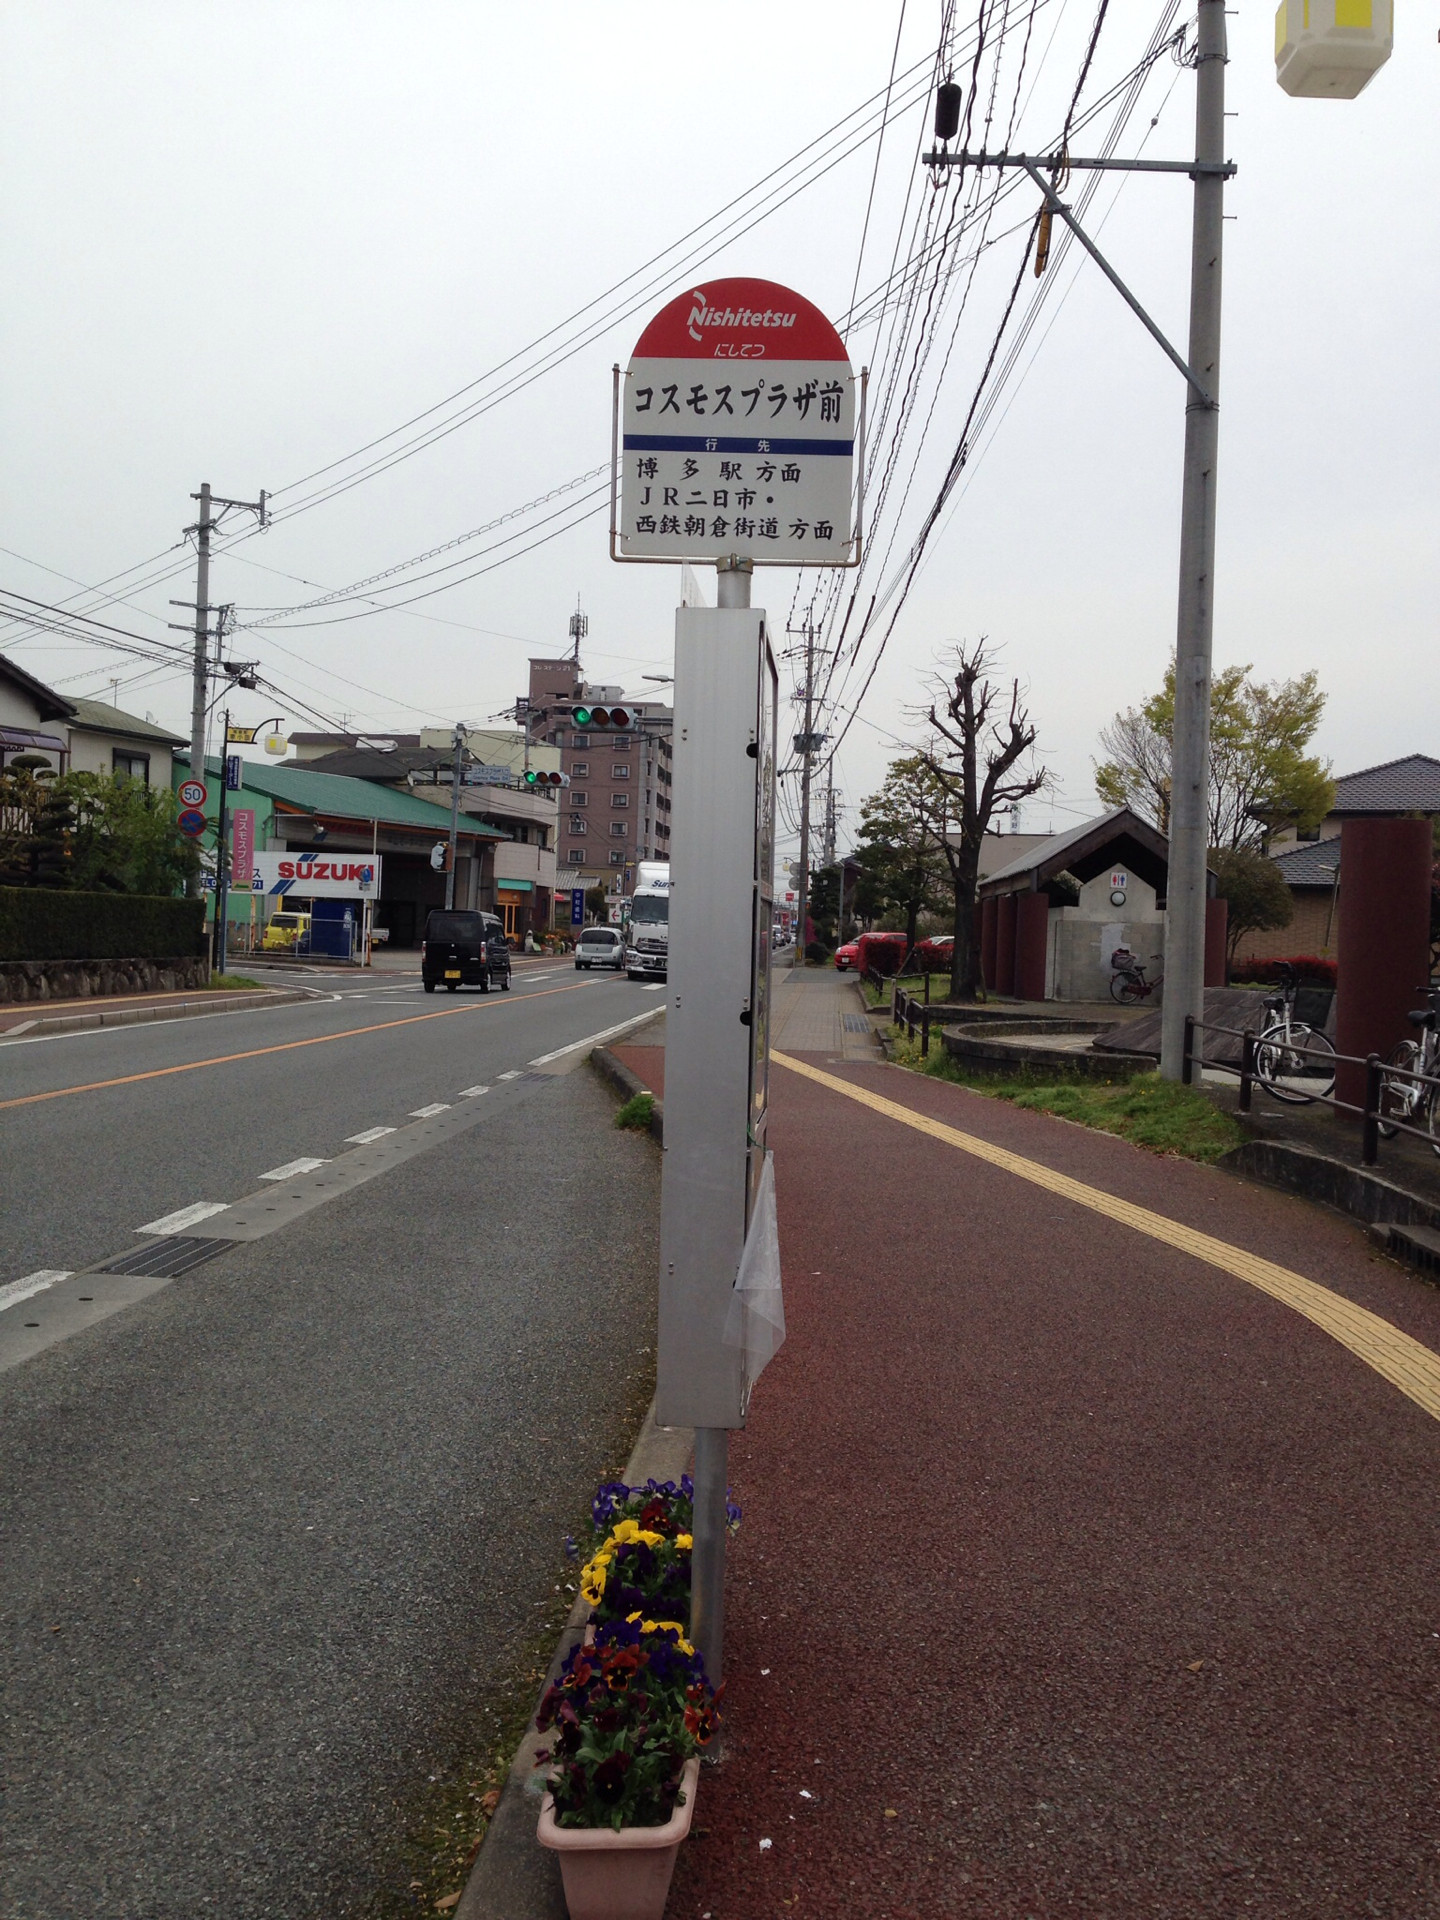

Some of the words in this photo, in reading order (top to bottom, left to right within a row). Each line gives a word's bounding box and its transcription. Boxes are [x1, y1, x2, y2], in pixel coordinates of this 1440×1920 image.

[686, 300, 797, 331] Nishitetsu
[713, 343, 766, 358] にしてつ
[635, 378, 844, 424] コスモスプラザ前
[184, 788, 201, 801] 50
[278, 862, 374, 881] SUZUKI
